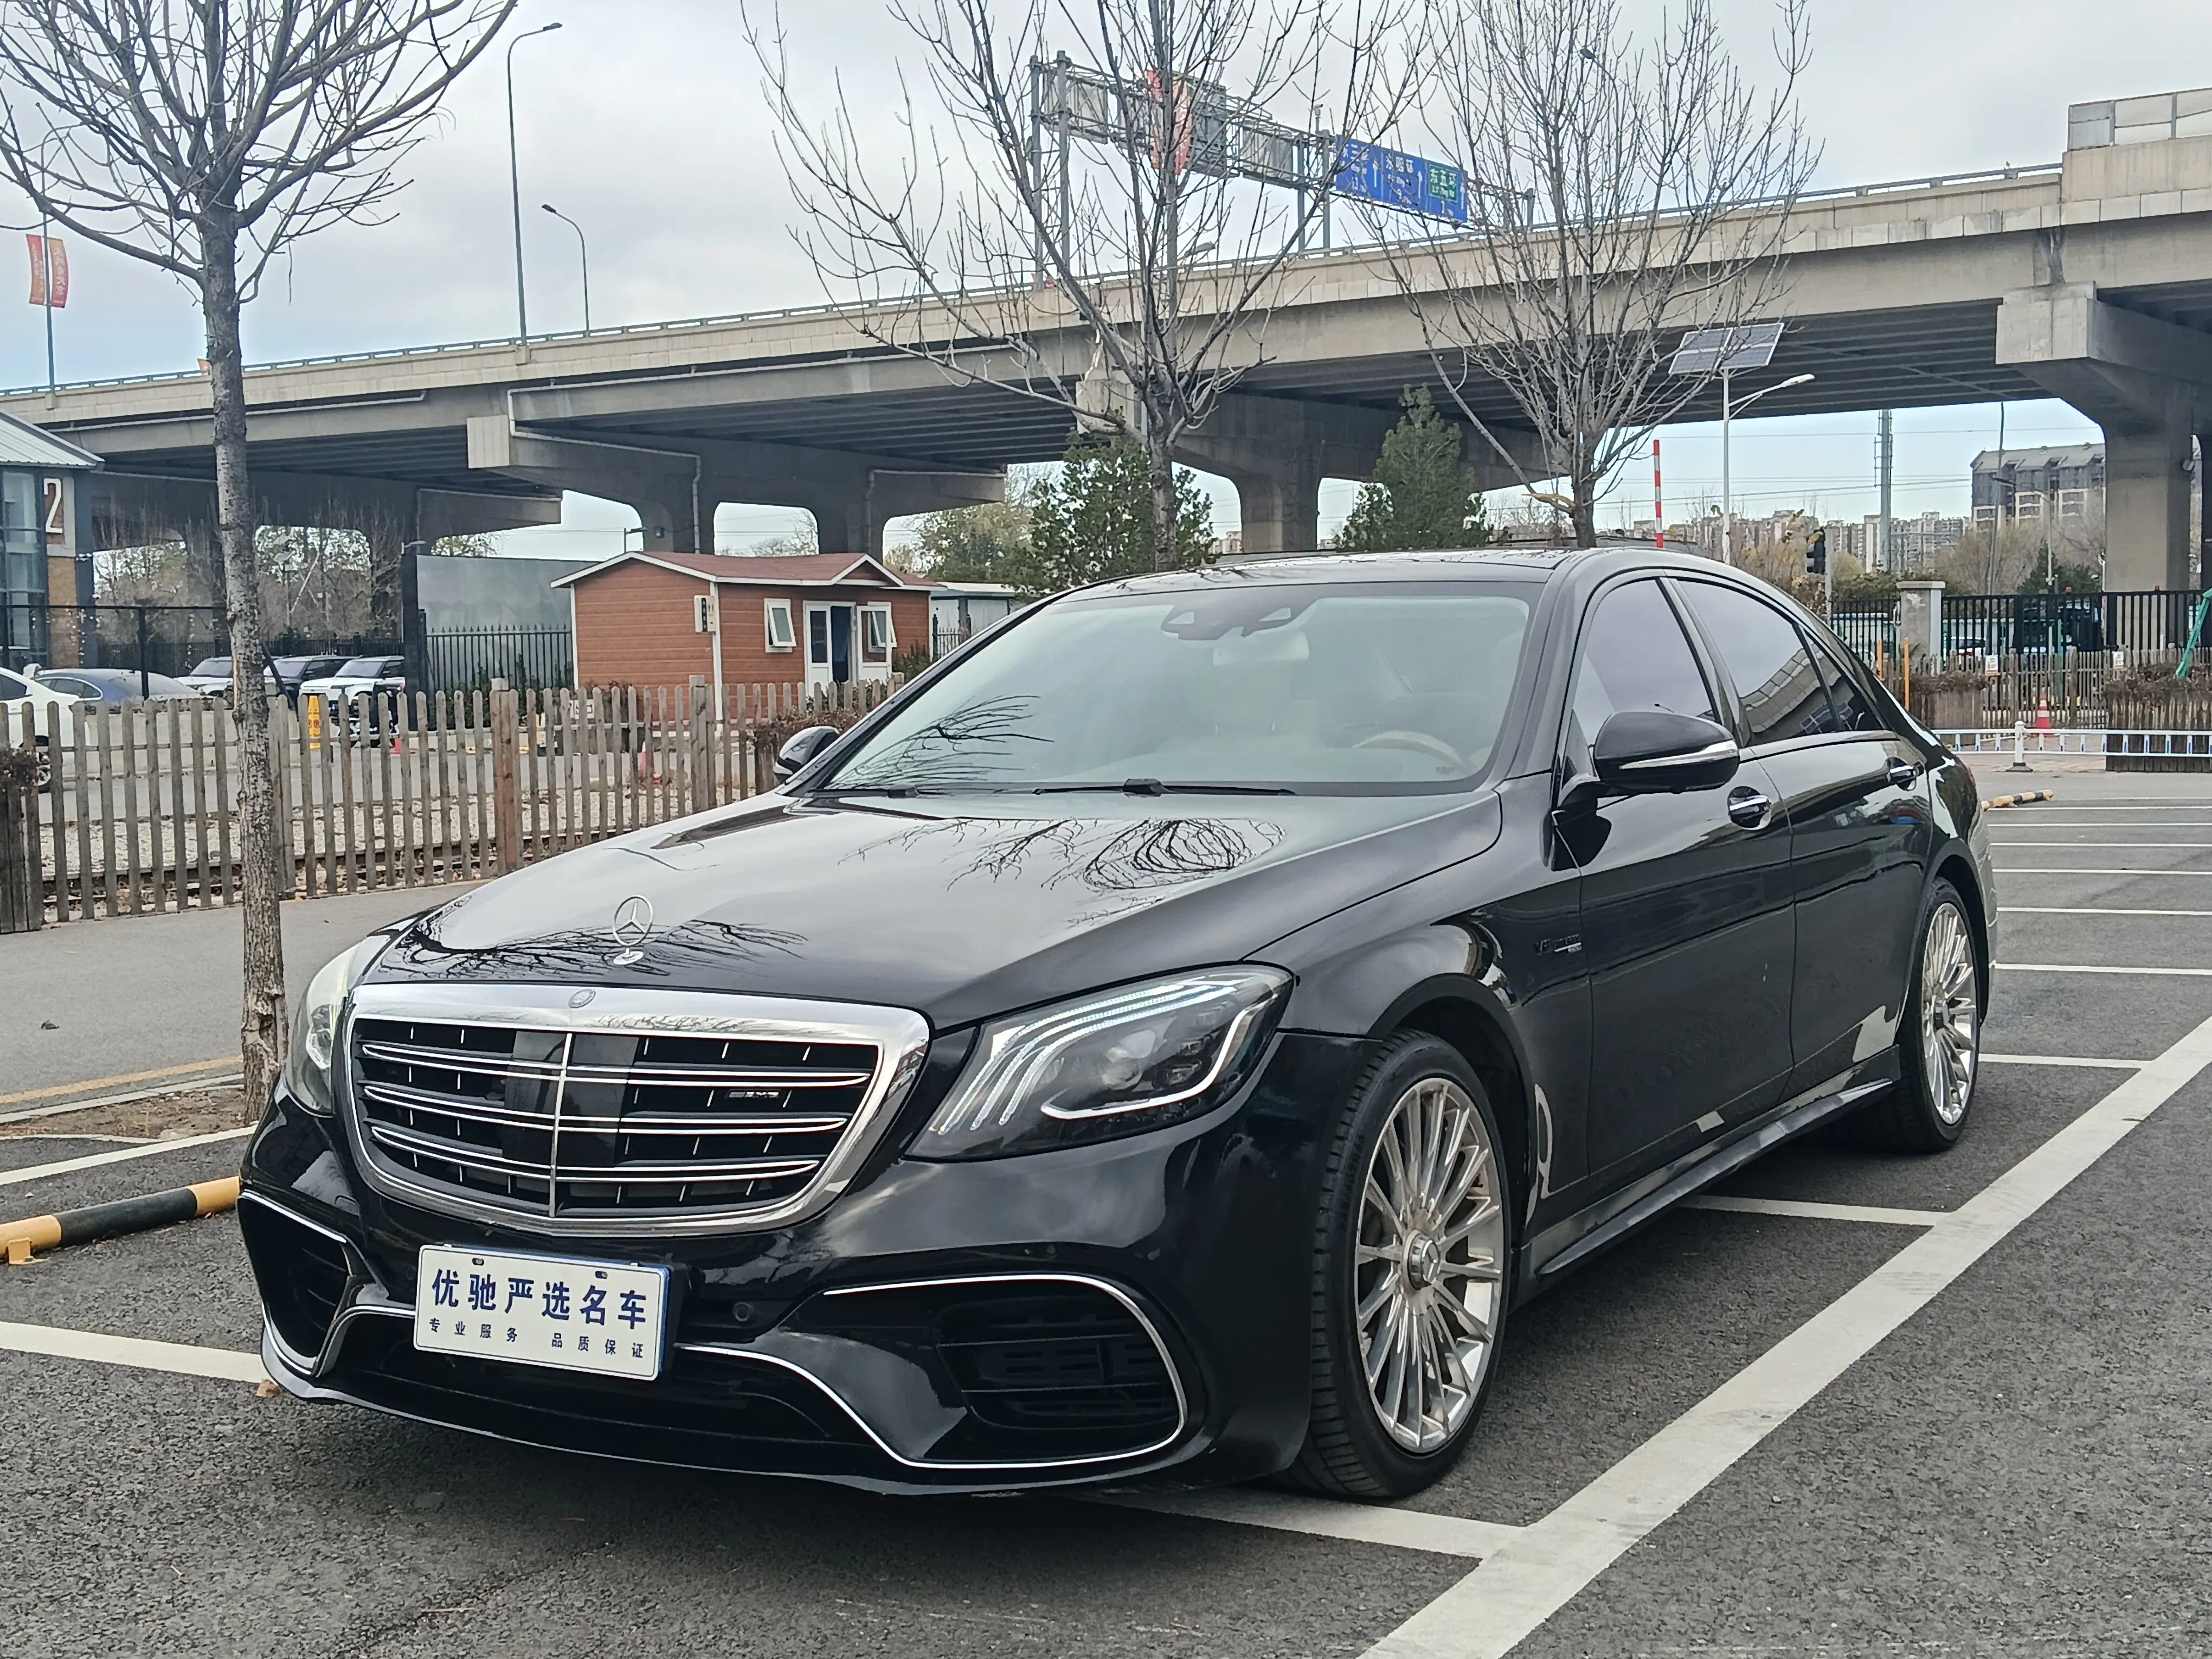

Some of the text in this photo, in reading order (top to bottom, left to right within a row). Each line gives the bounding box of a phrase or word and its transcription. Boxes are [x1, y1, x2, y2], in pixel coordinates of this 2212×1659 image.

[43, 478, 63, 533] 2
[432, 1269, 647, 1329] 优驰严选名车
[429, 1317, 644, 1359] 专业服务 品质保证
